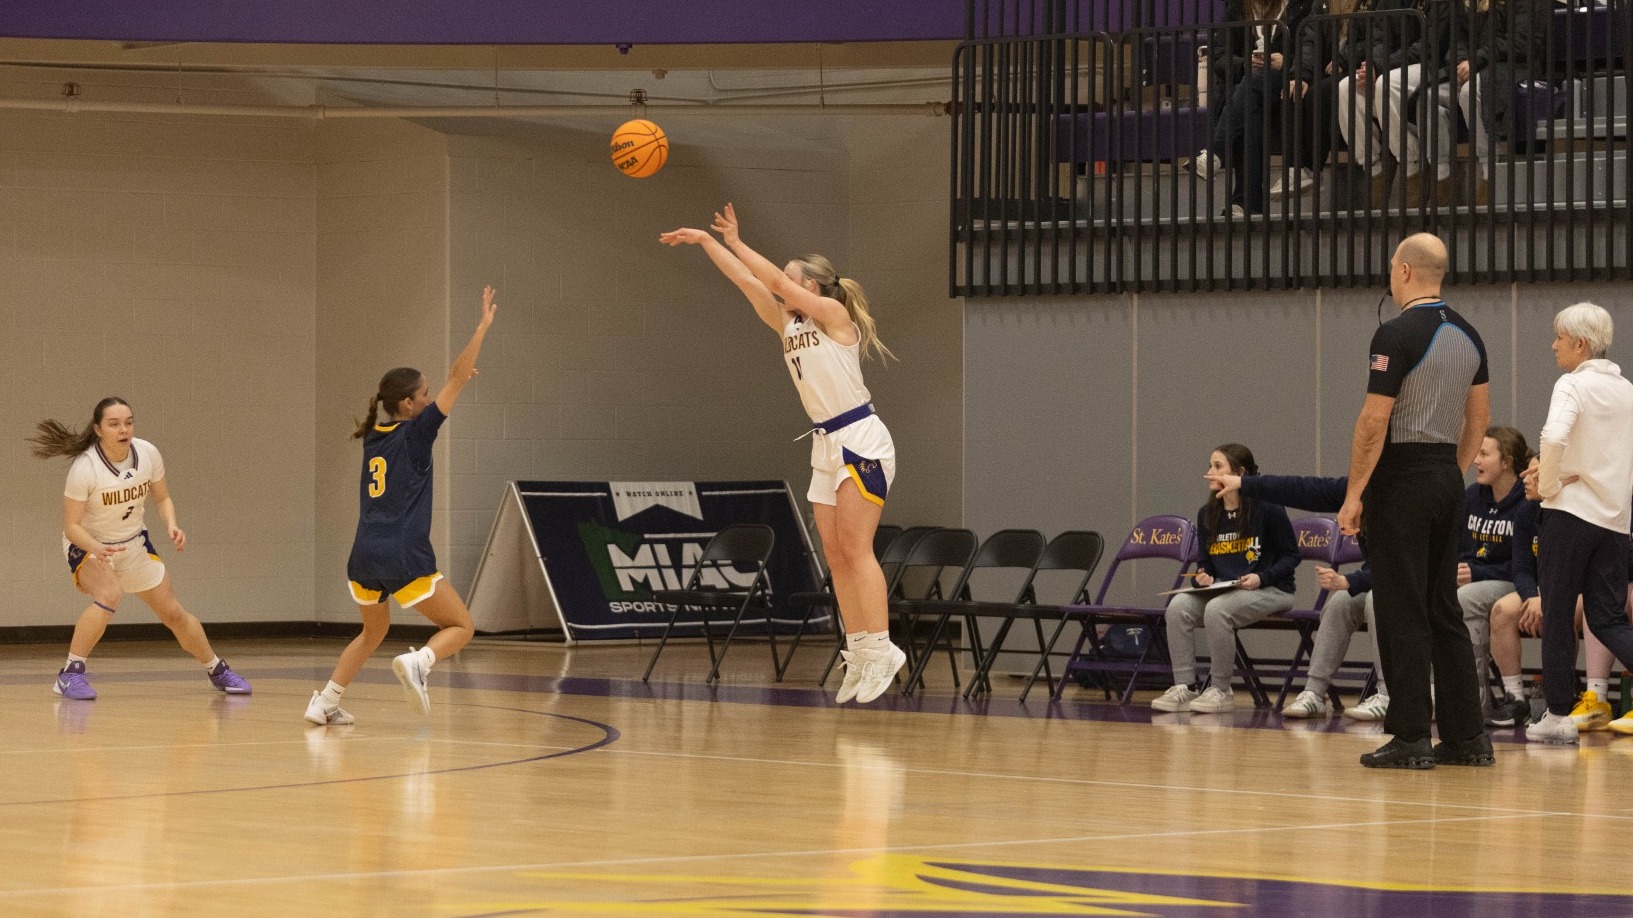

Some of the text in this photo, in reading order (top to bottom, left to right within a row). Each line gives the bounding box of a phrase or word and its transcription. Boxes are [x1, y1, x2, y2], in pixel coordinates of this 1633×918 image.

[368, 456, 388, 498] 3
[655, 490, 684, 498] ONLINE
[1130, 527, 1183, 545] St. Kate's
[1297, 529, 1332, 548] Kate's
